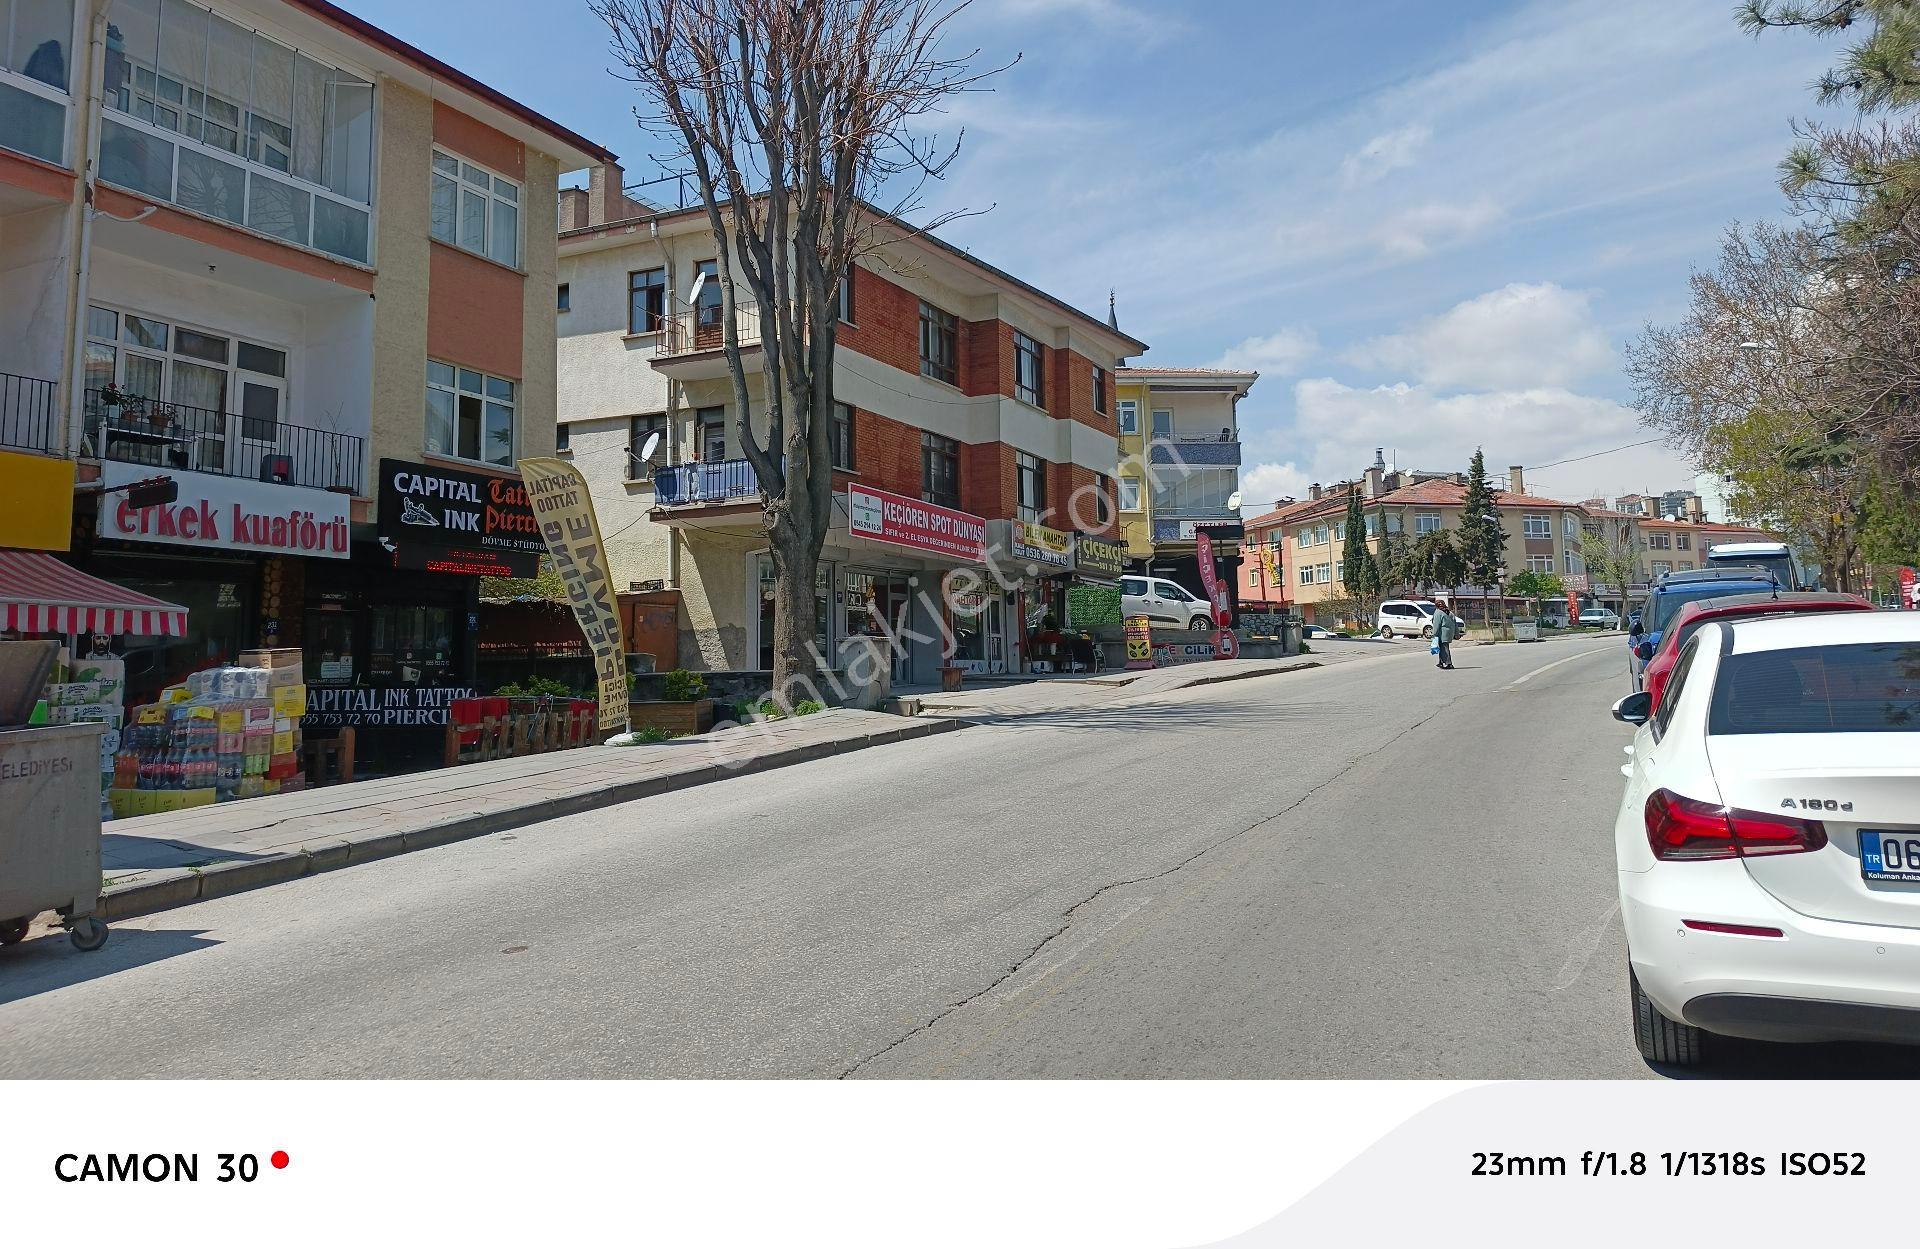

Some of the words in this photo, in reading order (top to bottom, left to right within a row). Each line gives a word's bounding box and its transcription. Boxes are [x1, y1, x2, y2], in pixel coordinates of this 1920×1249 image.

[393, 472, 482, 504] CAPITAL
[487, 479, 531, 507] Tat
[116, 498, 219, 540] erkek
[233, 503, 348, 552] kuaförü
[444, 508, 481, 532] INK
[485, 504, 539, 534] Pierci
[884, 501, 929, 530] KEÇİÖREN
[931, 514, 951, 534] SPOT
[953, 517, 985, 543] DÜNYASI
[513, 538, 548, 551] STÜDYO
[1083, 537, 1121, 564] ÇİÇEKÇİ
[305, 689, 381, 711] APITAL
[384, 689, 410, 707] INK
[322, 713, 342, 725] 753
[346, 713, 361, 725] 72
[364, 713, 381, 725] 70
[384, 709, 451, 725] PIERCI
[0, 757, 73, 780] ELEDİYESİ
[1865, 854, 1881, 864] TR
[1882, 838, 1920, 870] 06
[1867, 872, 1901, 880] Koluman
[1901, 873, 1920, 881] Anka
